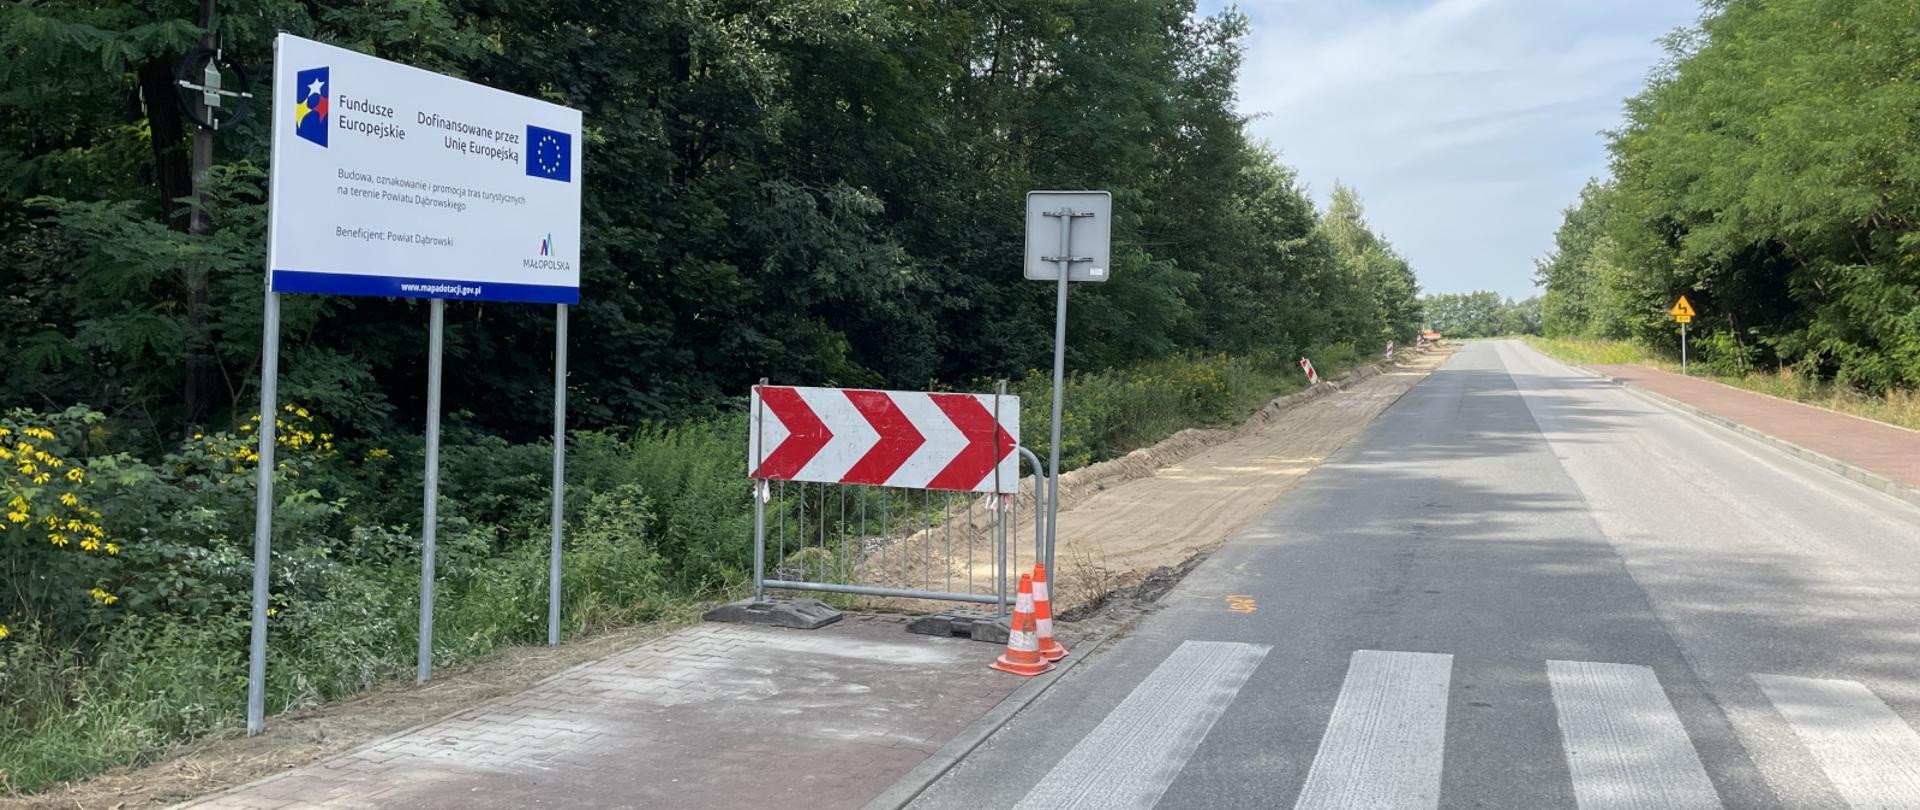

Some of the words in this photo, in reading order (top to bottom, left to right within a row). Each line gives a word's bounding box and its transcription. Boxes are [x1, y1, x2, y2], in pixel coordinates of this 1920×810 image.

[339, 94, 394, 118] Fundusze
[339, 115, 406, 140] Europejskie
[417, 111, 493, 139] Dofinansowane
[495, 130, 520, 144] przez
[444, 135, 467, 154] Unię
[469, 140, 519, 164] Europejską
[337, 168, 374, 184] Budowa,
[376, 174, 427, 191] oznakowanie
[432, 183, 466, 198] promocja
[467, 188, 481, 198] tras
[482, 191, 526, 206] turystycznych
[337, 186, 349, 196] na
[350, 186, 380, 199] terenie
[381, 190, 414, 204] Powiatu
[414, 194, 467, 212] Dąbrowskiego
[335, 225, 385, 242] Beneficjent:
[387, 231, 414, 244] Powiat
[414, 234, 454, 247] Dąbrowski
[522, 258, 570, 271] MAŁOPOLSKA
[400, 283, 482, 297] www.mapadotacji.gov.pl
